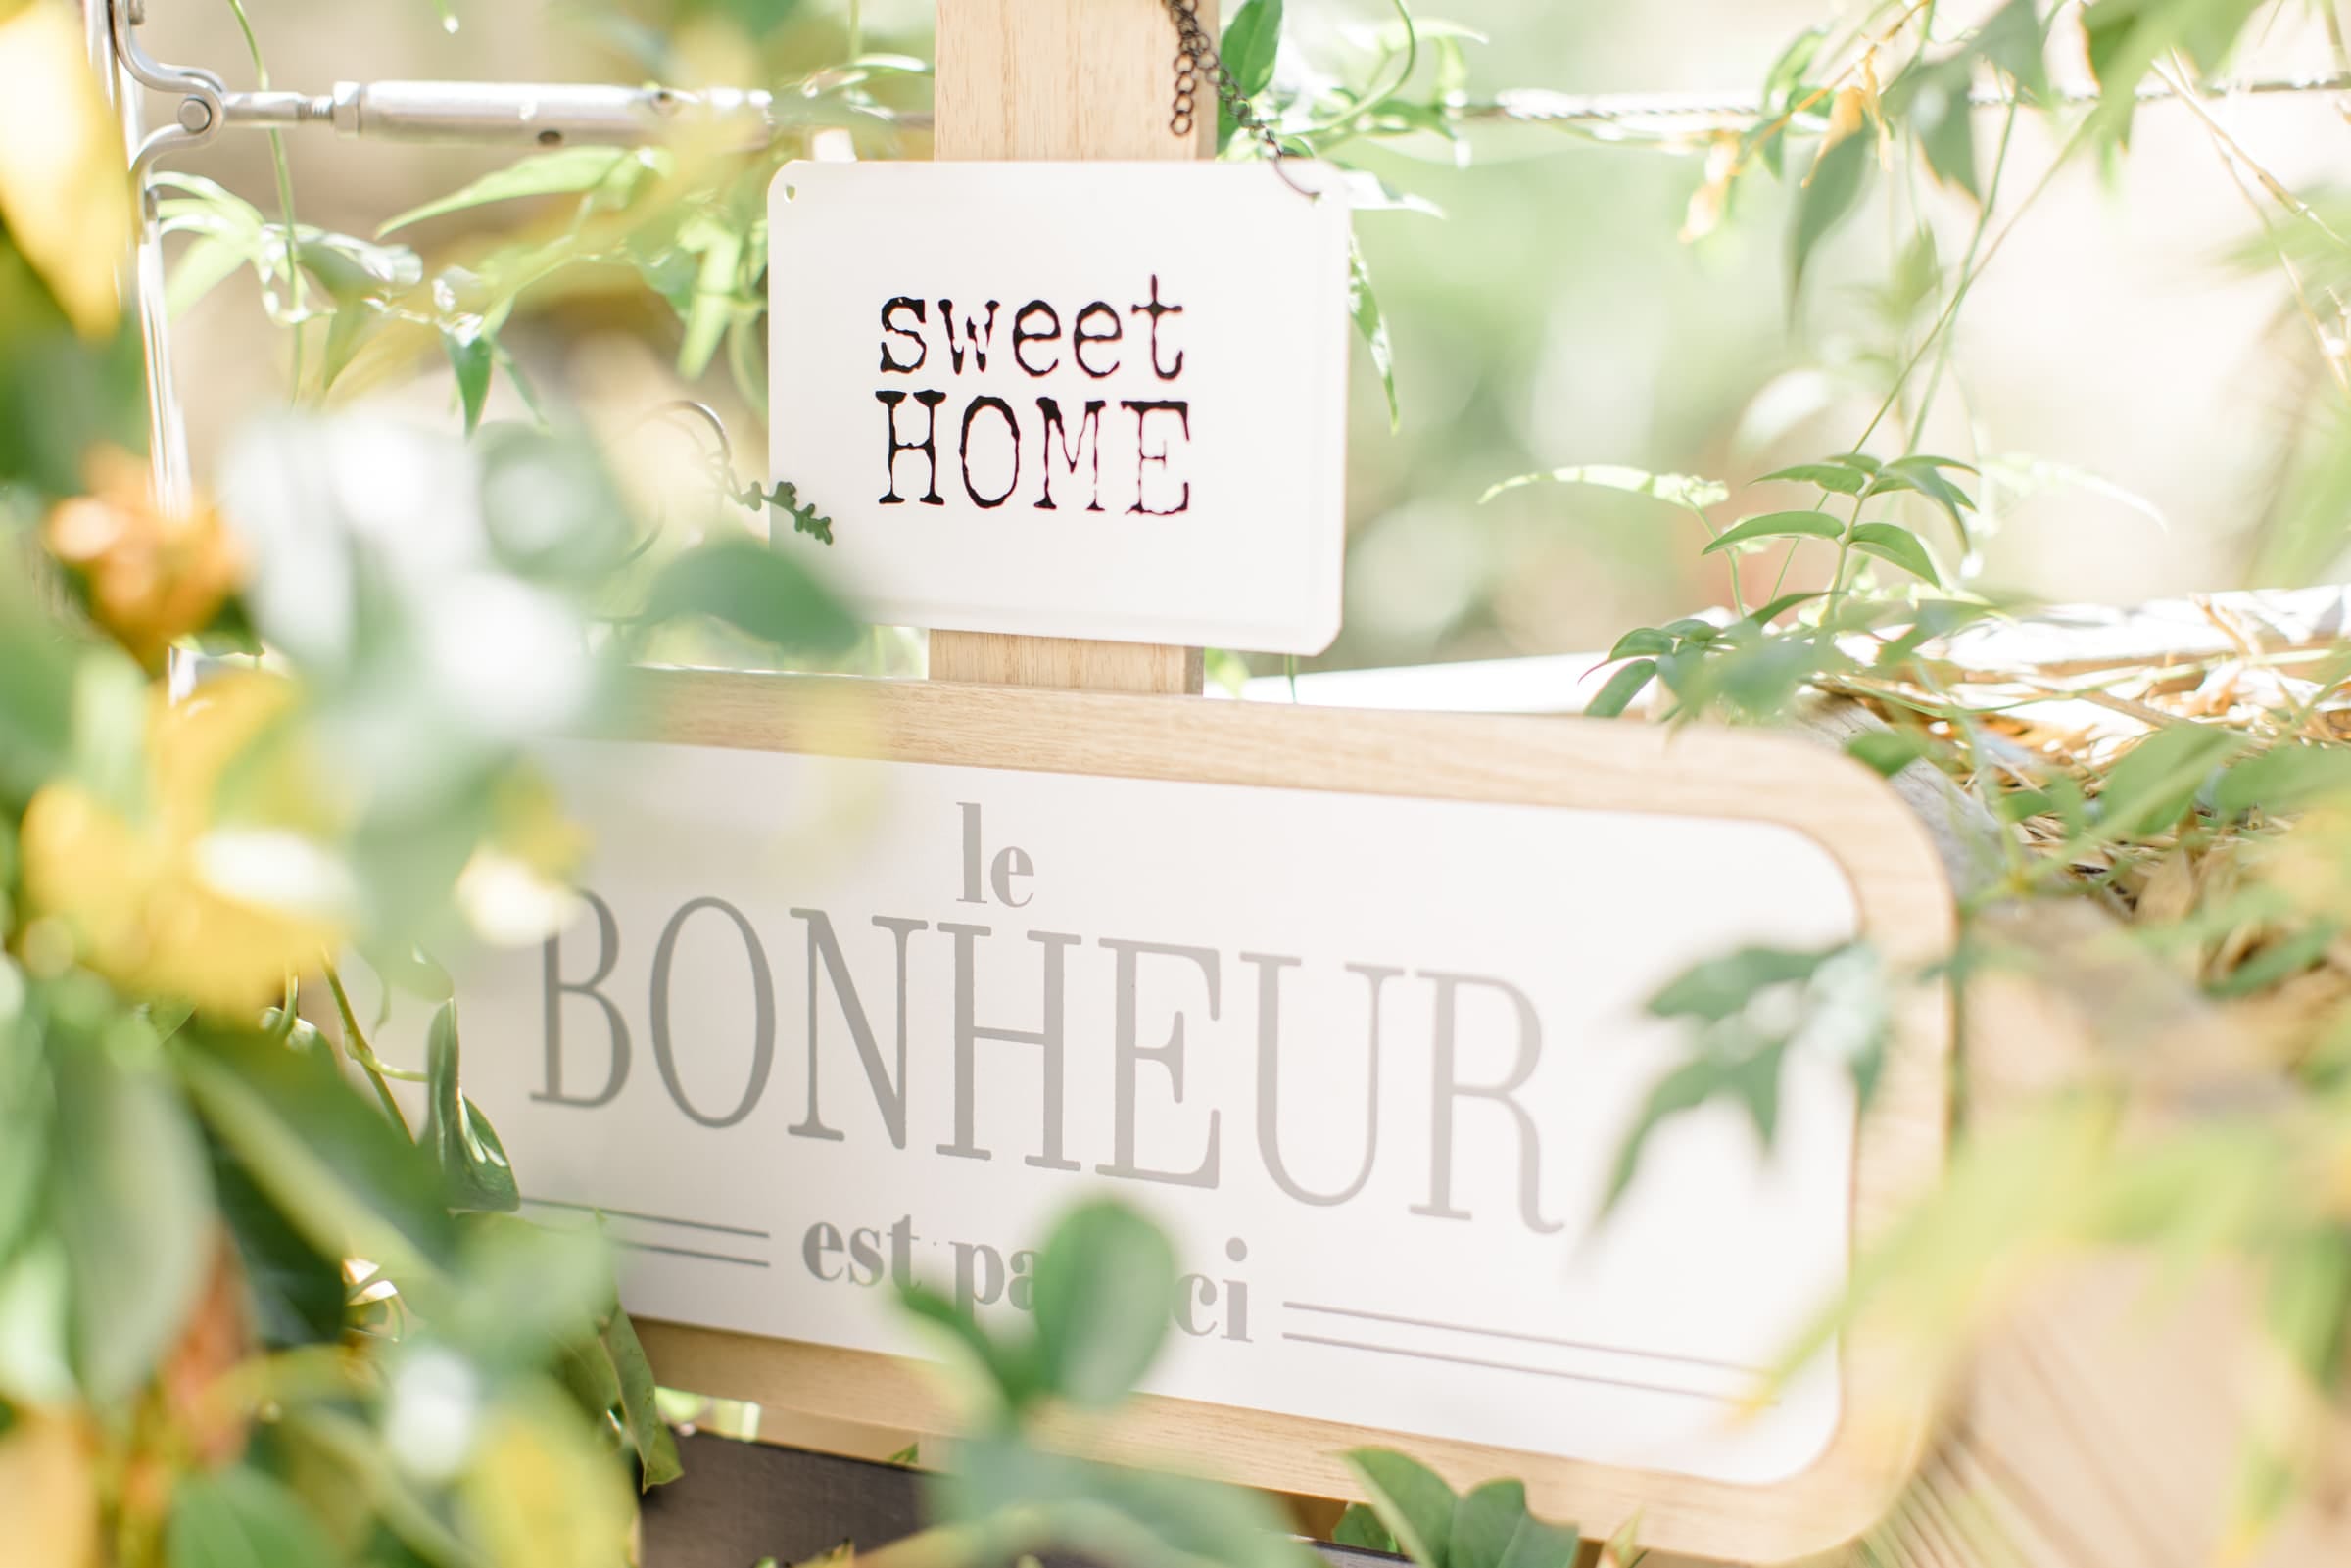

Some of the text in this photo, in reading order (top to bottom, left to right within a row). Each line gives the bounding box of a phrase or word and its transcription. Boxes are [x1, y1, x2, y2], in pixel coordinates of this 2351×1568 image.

[880, 273, 1185, 381] sweet
[875, 389, 1191, 516] HOME
[956, 801, 1035, 908] le
[529, 886, 1564, 1235] BONHEUR
[802, 1214, 1254, 1343] est pa ci
